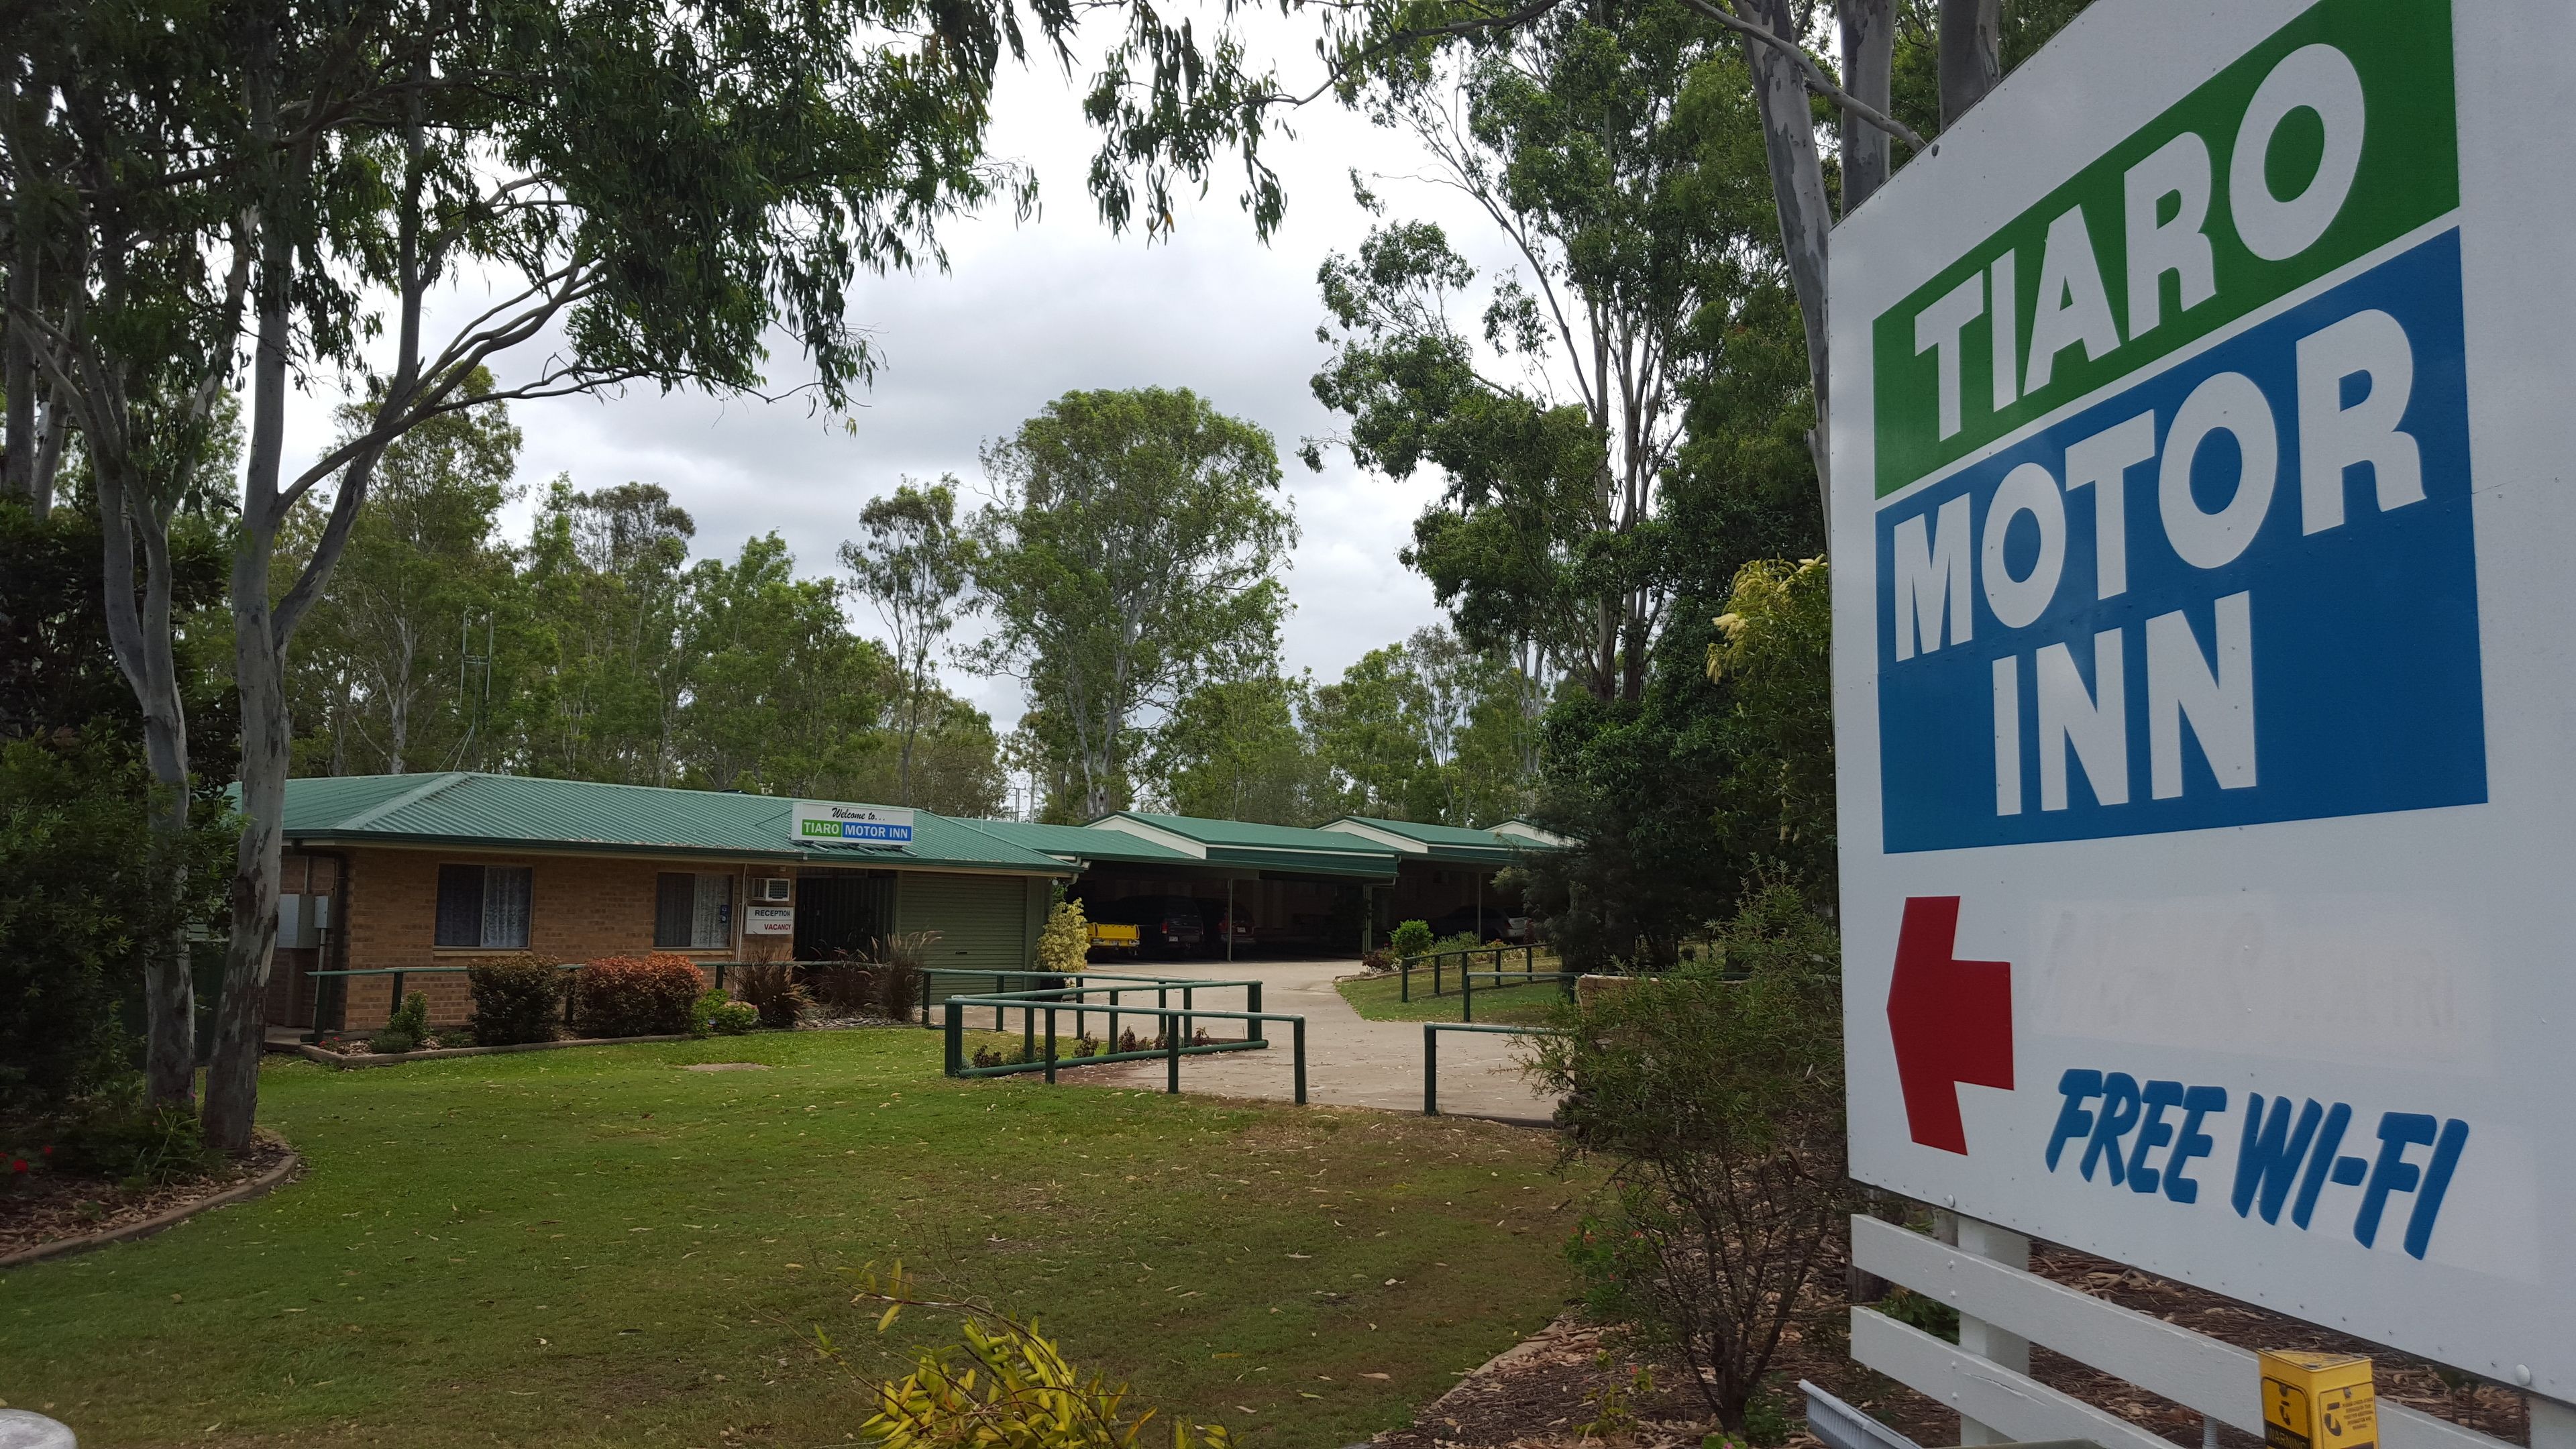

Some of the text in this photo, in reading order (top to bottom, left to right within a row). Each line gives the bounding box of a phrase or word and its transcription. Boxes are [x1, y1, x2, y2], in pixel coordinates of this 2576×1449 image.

[1914, 42, 2366, 443] TIARO
[1893, 308, 2427, 663] MOTOR
[1992, 590, 2257, 816] INN
[804, 822, 908, 839] TIARO MOTOR INN
[831, 807, 865, 820] Welcome
[2045, 1069, 2469, 1260] FREE WI-FI
